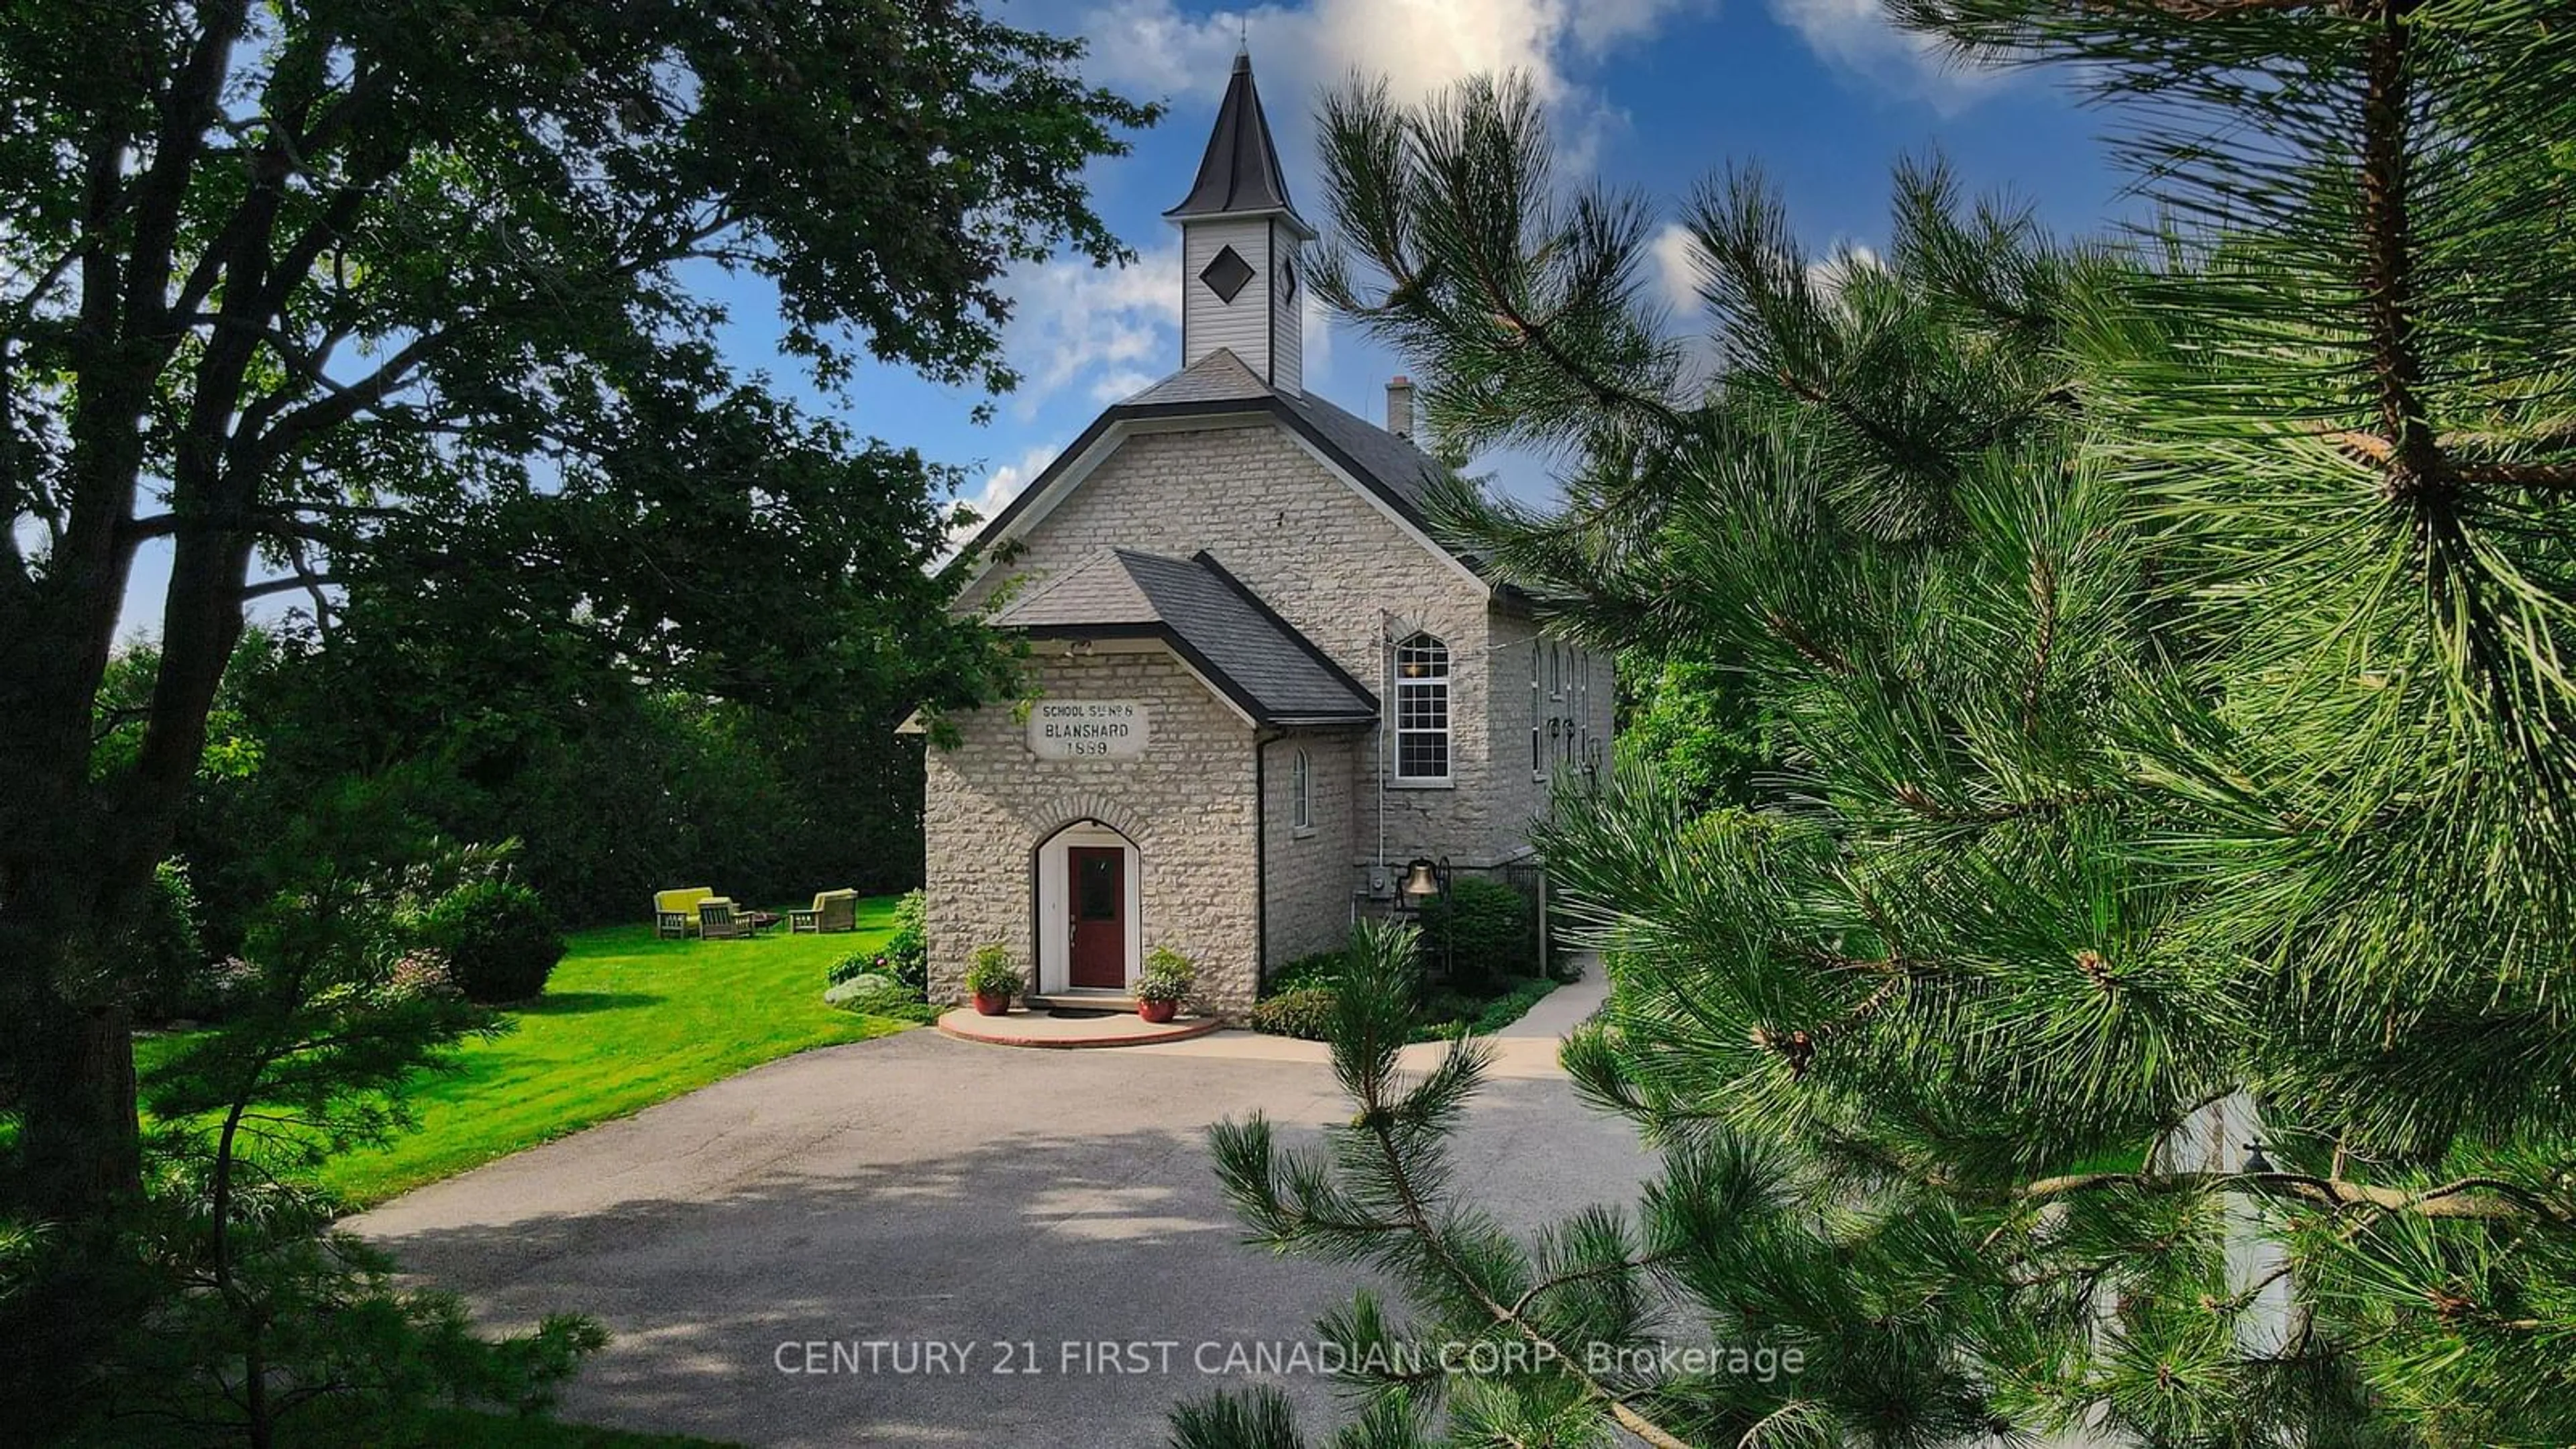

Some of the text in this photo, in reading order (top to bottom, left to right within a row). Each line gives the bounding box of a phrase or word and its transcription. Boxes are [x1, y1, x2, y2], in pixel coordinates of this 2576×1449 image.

[1043, 706, 1084, 717] SCHOOL
[1125, 705, 1133, 717] 8
[1046, 724, 1128, 737] BLANSHARD
[1067, 741, 1107, 755] 1889
